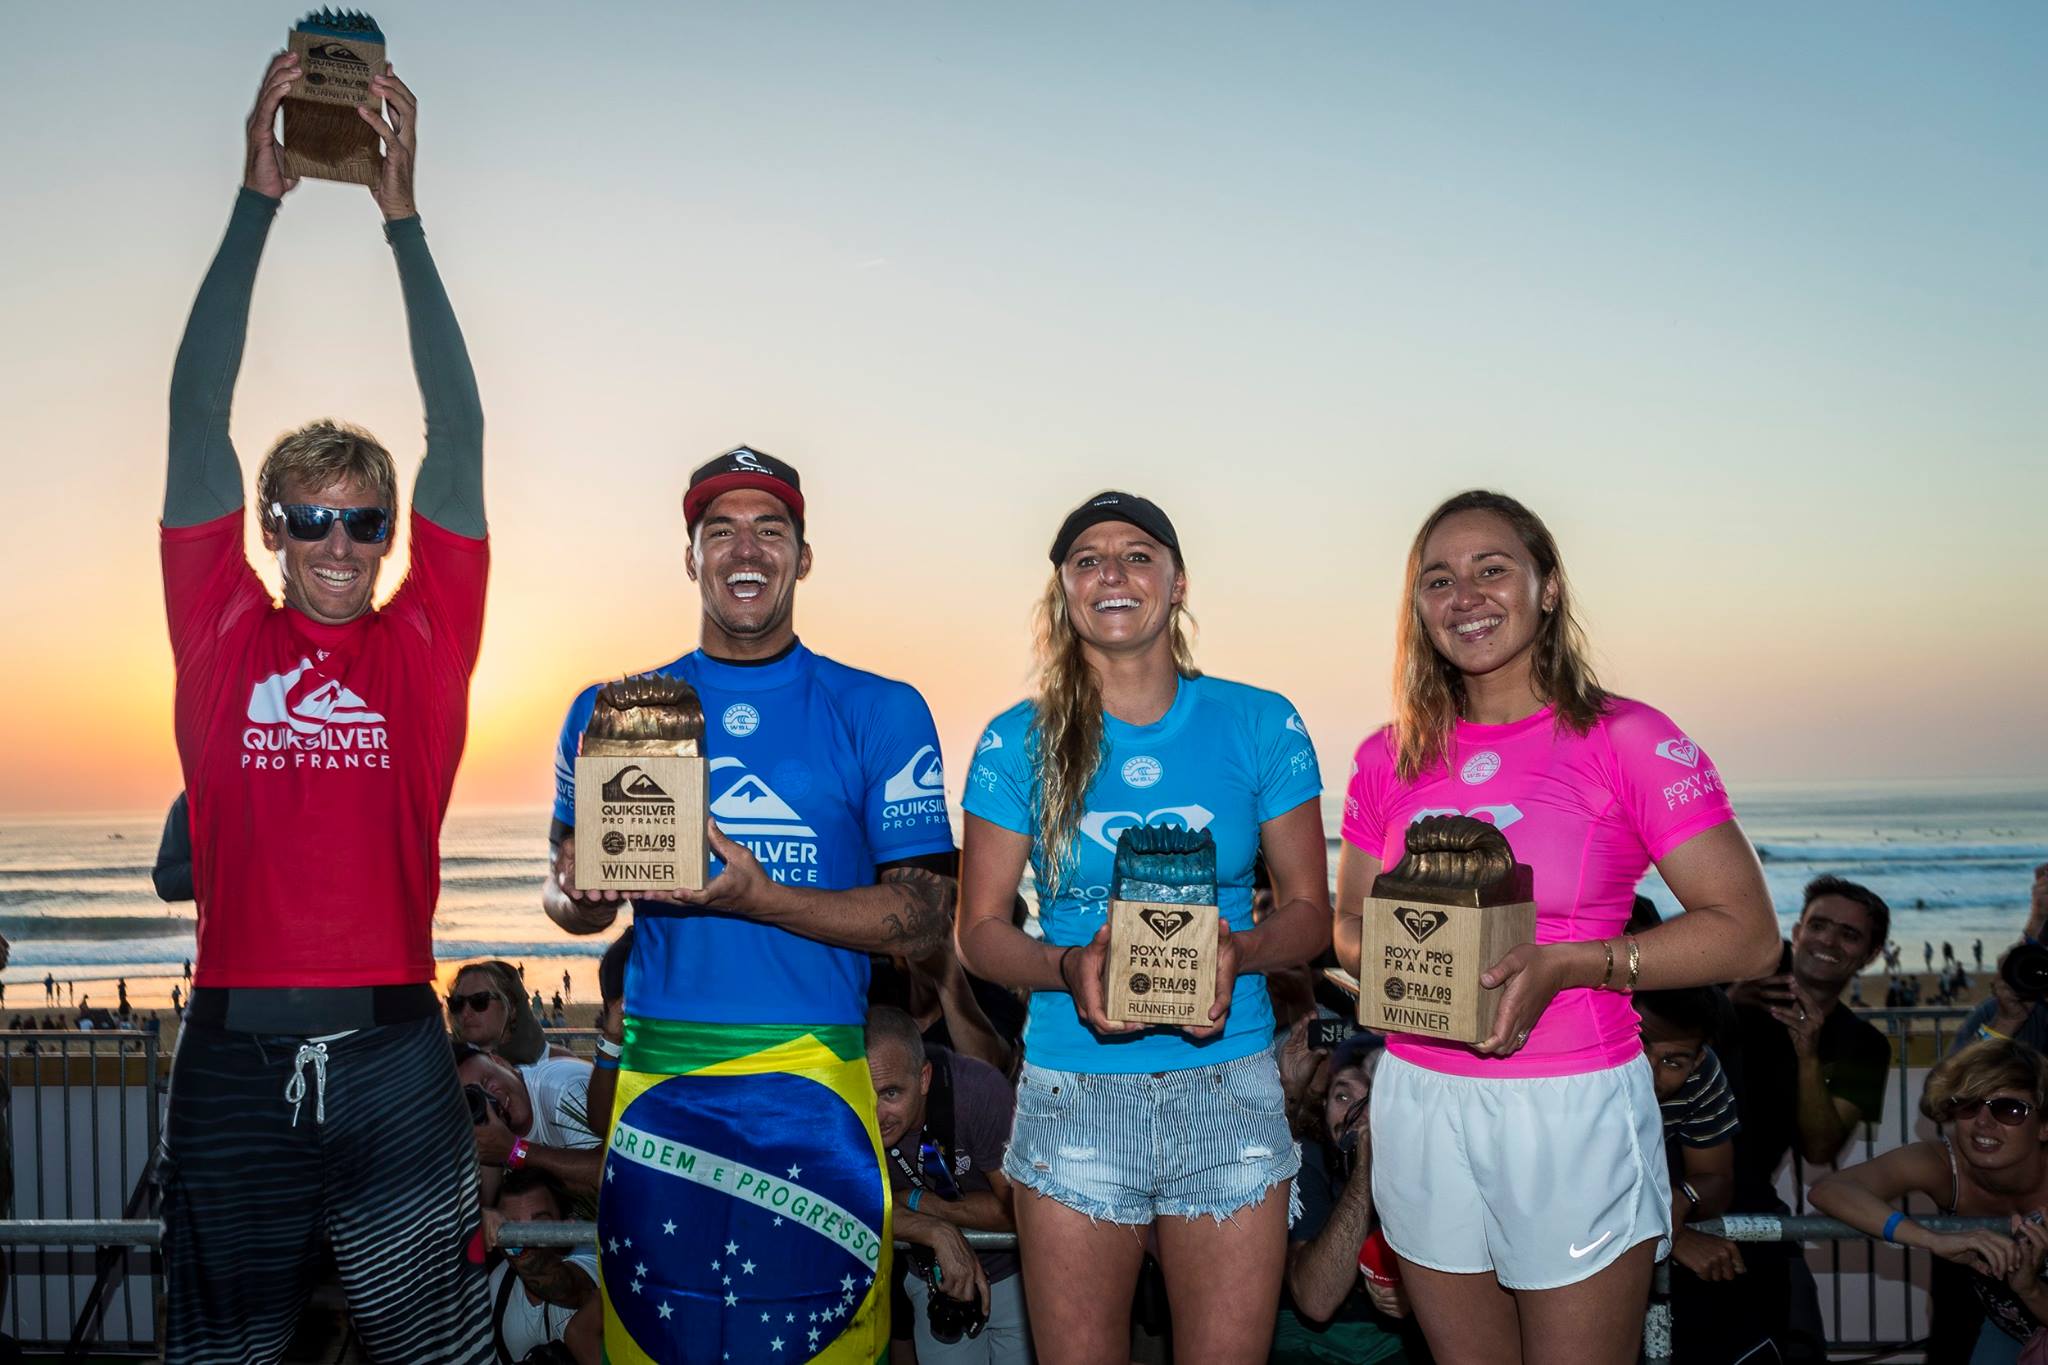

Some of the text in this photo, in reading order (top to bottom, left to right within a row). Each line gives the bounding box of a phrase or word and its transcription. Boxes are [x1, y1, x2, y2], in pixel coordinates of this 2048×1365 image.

[309, 60, 370, 73] QUIKSILVER
[242, 727, 389, 751] QUIKSILVER
[241, 753, 391, 770] PRO FRANCE
[1663, 773, 1701, 800] ROXY
[1667, 780, 1722, 811] FRANC
[601, 805, 675, 817] QUIKSILVER
[882, 799, 946, 819] QUIKSIL
[602, 817, 676, 825] PRO FRANCE
[882, 815, 947, 832] PRO FRA
[628, 834, 676, 848] FRA/09
[601, 863, 675, 880] WINNER
[772, 868, 817, 883] NCE
[1130, 944, 1198, 959] ROXY PRO
[1385, 946, 1454, 965] ROXY PRO
[1129, 957, 1198, 970] FRANCE
[1384, 959, 1454, 978] FRANCE
[1152, 976, 1197, 992] FRA/09
[1407, 982, 1452, 1001] FRA/09
[1128, 1002, 1196, 1016] RUNNER UP
[1383, 1006, 1449, 1031] WINNER
[1321, 1024, 1335, 1043] 72
[614, 1126, 881, 1263] ORDEM E PROGRESSO
